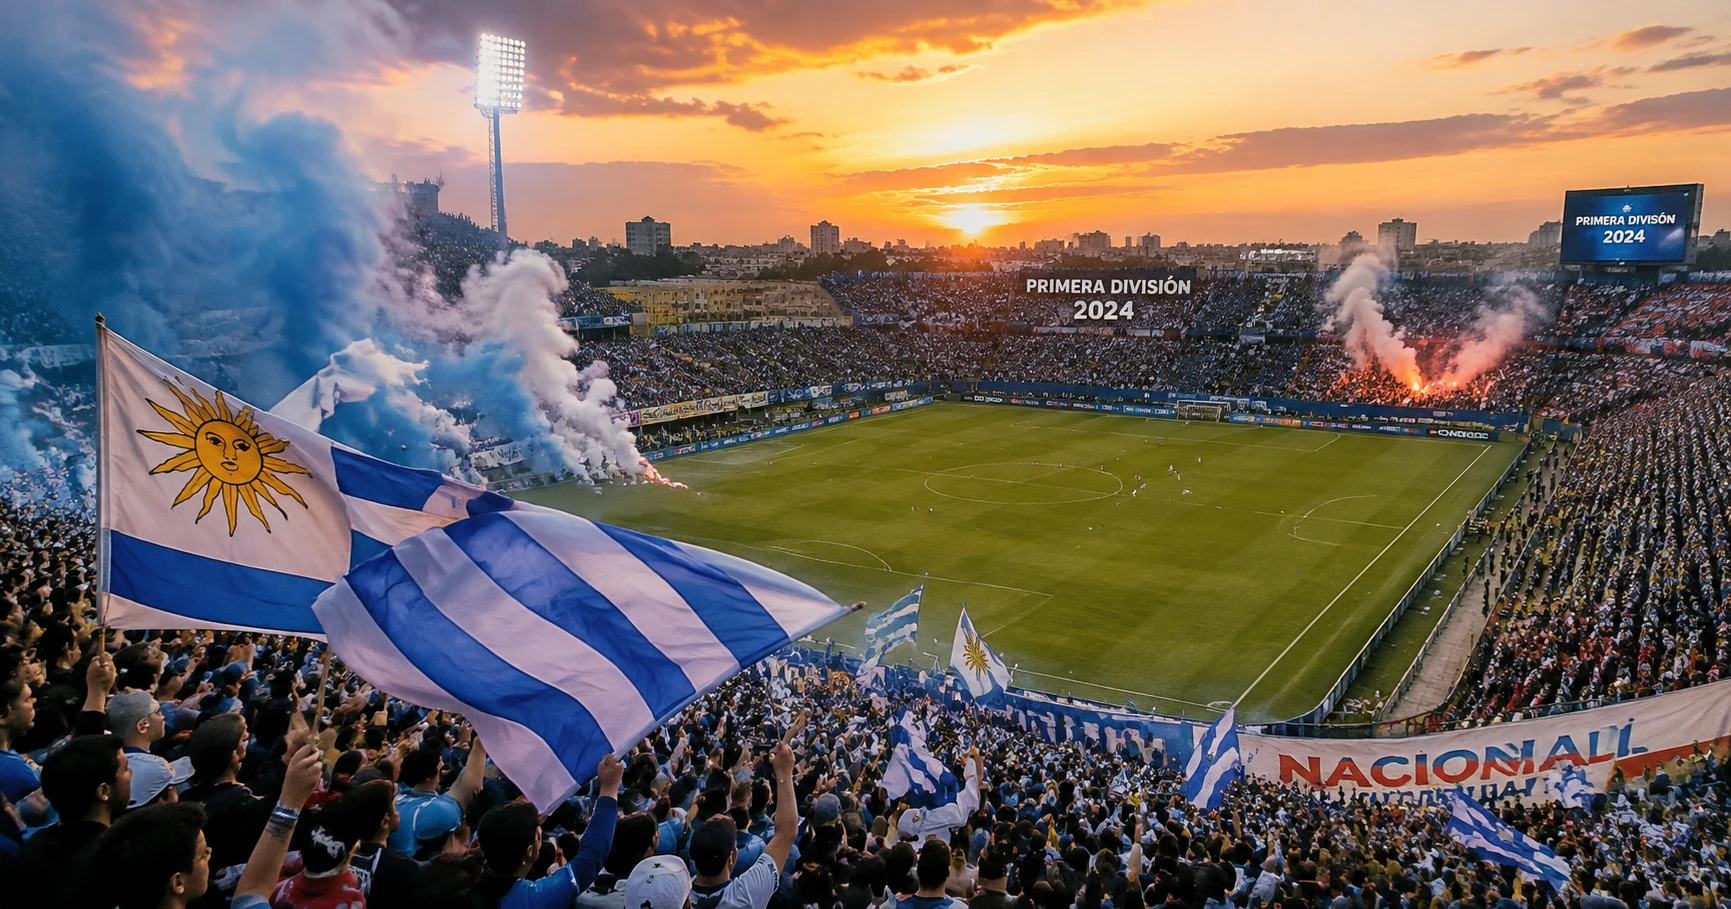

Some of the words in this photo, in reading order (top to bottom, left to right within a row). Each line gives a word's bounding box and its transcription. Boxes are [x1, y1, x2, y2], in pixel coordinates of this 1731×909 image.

[1576, 215, 1625, 226] PRIMERA
[1627, 212, 1676, 225] DIVISÓN
[1602, 229, 1646, 244] 2024
[1026, 278, 1106, 294] PRIMERA
[1110, 275, 1192, 295] DIVISIÓN
[1073, 300, 1135, 321] 2024
